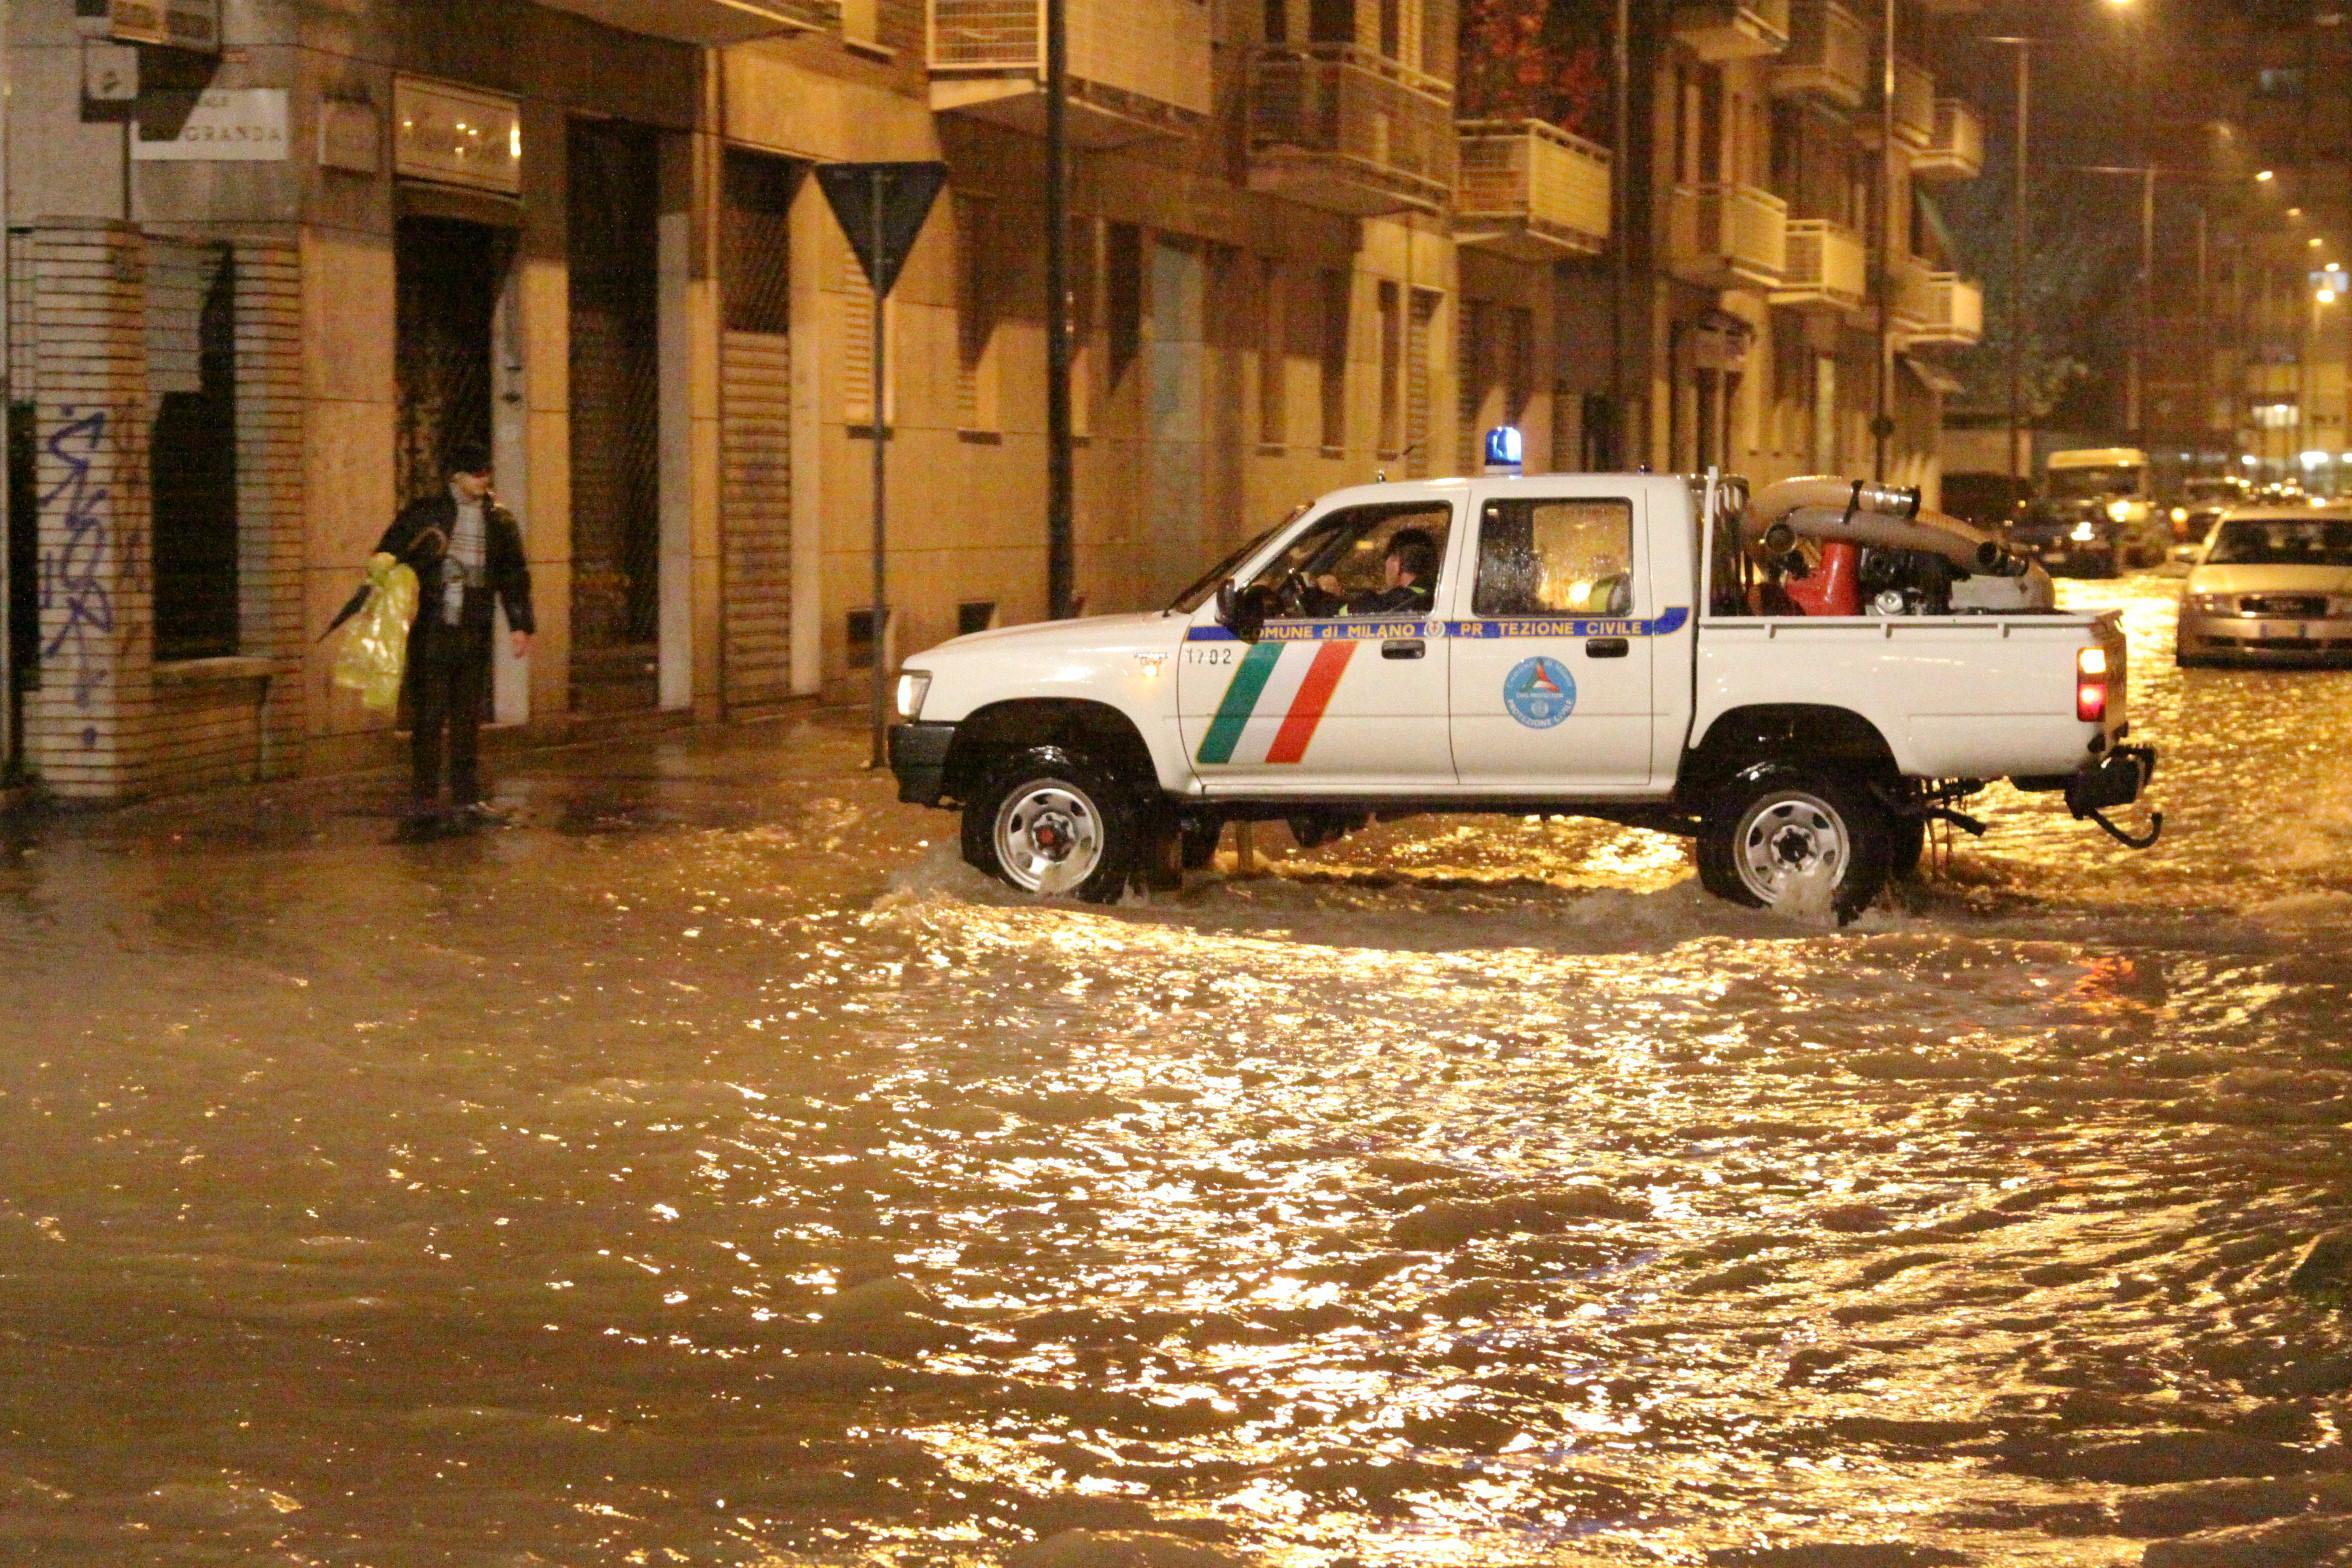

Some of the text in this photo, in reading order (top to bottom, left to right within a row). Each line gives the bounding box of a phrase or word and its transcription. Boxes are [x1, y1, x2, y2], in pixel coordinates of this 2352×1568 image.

[1259, 624, 1313, 639] MUNE
[1322, 624, 1338, 638] di
[1347, 623, 1416, 639] MILANO
[1586, 621, 1642, 635] CIVILE
[1186, 648, 1232, 665] 1702
